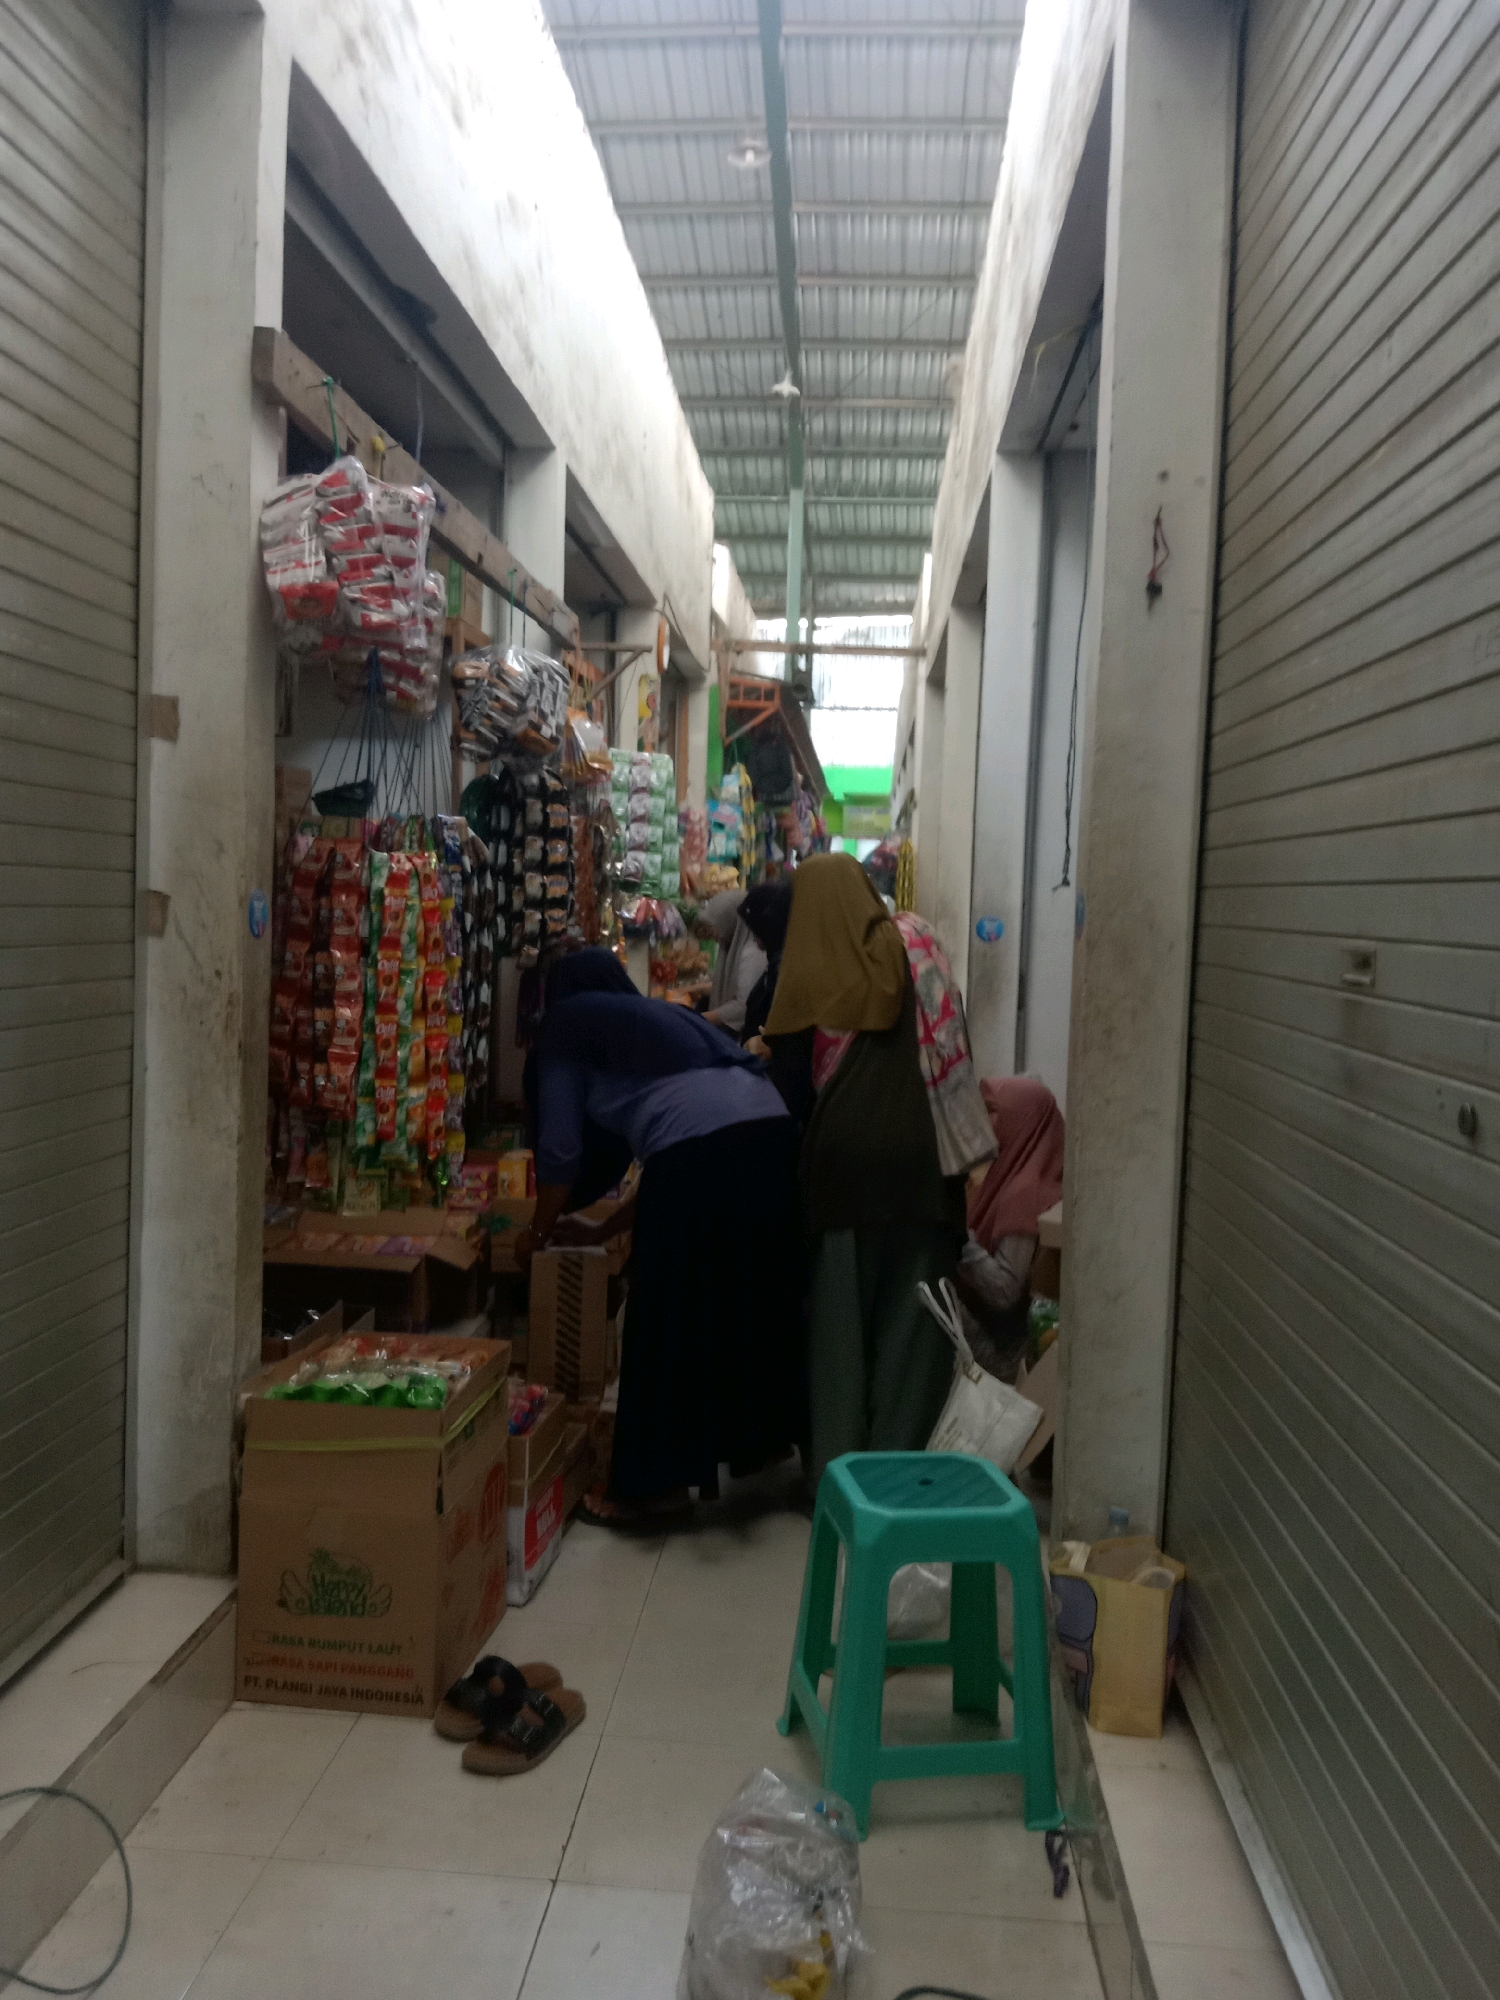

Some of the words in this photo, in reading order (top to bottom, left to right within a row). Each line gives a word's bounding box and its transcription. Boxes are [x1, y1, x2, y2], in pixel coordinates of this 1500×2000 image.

[312, 1573, 366, 1602] Happy
[272, 1634, 304, 1647] RASA
[308, 1637, 363, 1653] RUMPUT
[367, 1641, 402, 1656] LAUT
[272, 1656, 304, 1669] RASA
[308, 1660, 338, 1673] SAPI
[341, 1662, 414, 1679] PANGGANG
[244, 1675, 262, 1688] PT.
[266, 1678, 313, 1693] PLANGI
[317, 1685, 347, 1697] JAYA
[351, 1688, 424, 1705] INDONESIA
